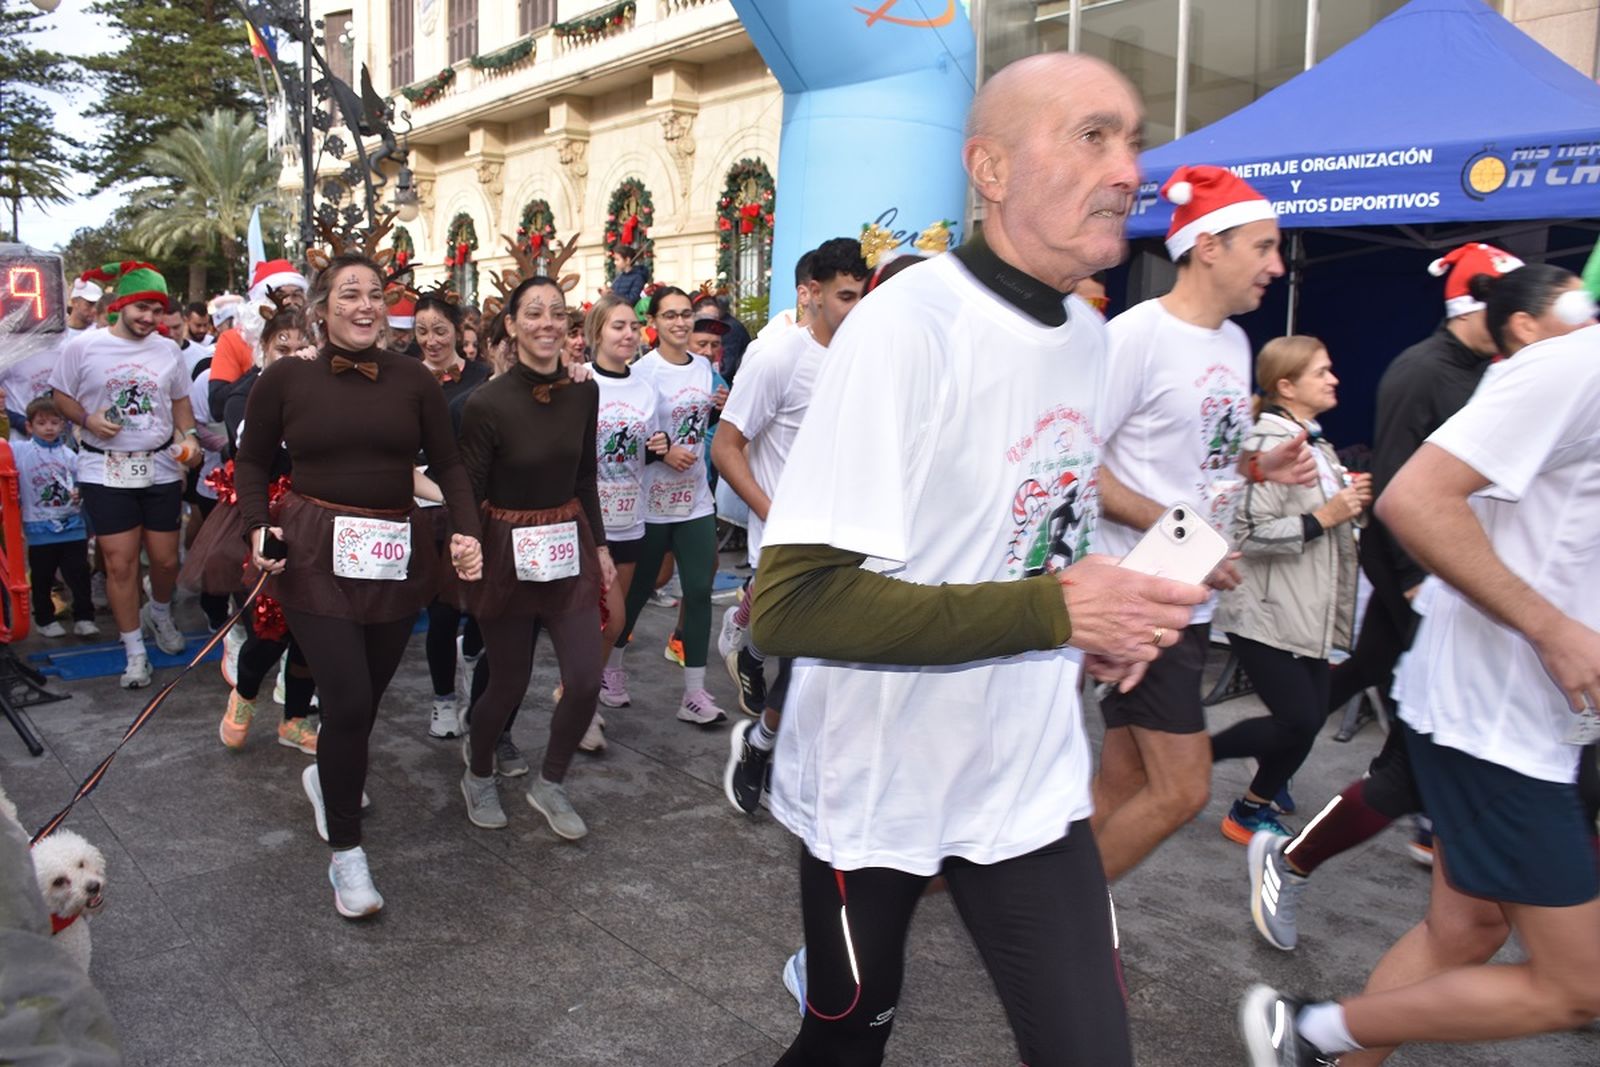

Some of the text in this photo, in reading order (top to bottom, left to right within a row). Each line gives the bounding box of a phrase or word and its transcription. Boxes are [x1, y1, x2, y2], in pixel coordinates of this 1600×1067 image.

[1511, 145, 1552, 161] MIS
[1223, 147, 1433, 178] METRAJE ORGANIZACIÓN
[1290, 179, 1302, 194] Y
[1330, 191, 1440, 212] DEPORTIVOS
[130, 465, 148, 476] 59
[616, 498, 635, 512] 327
[669, 490, 692, 504] 326
[370, 541, 405, 561] 400
[548, 542, 575, 562] 399
